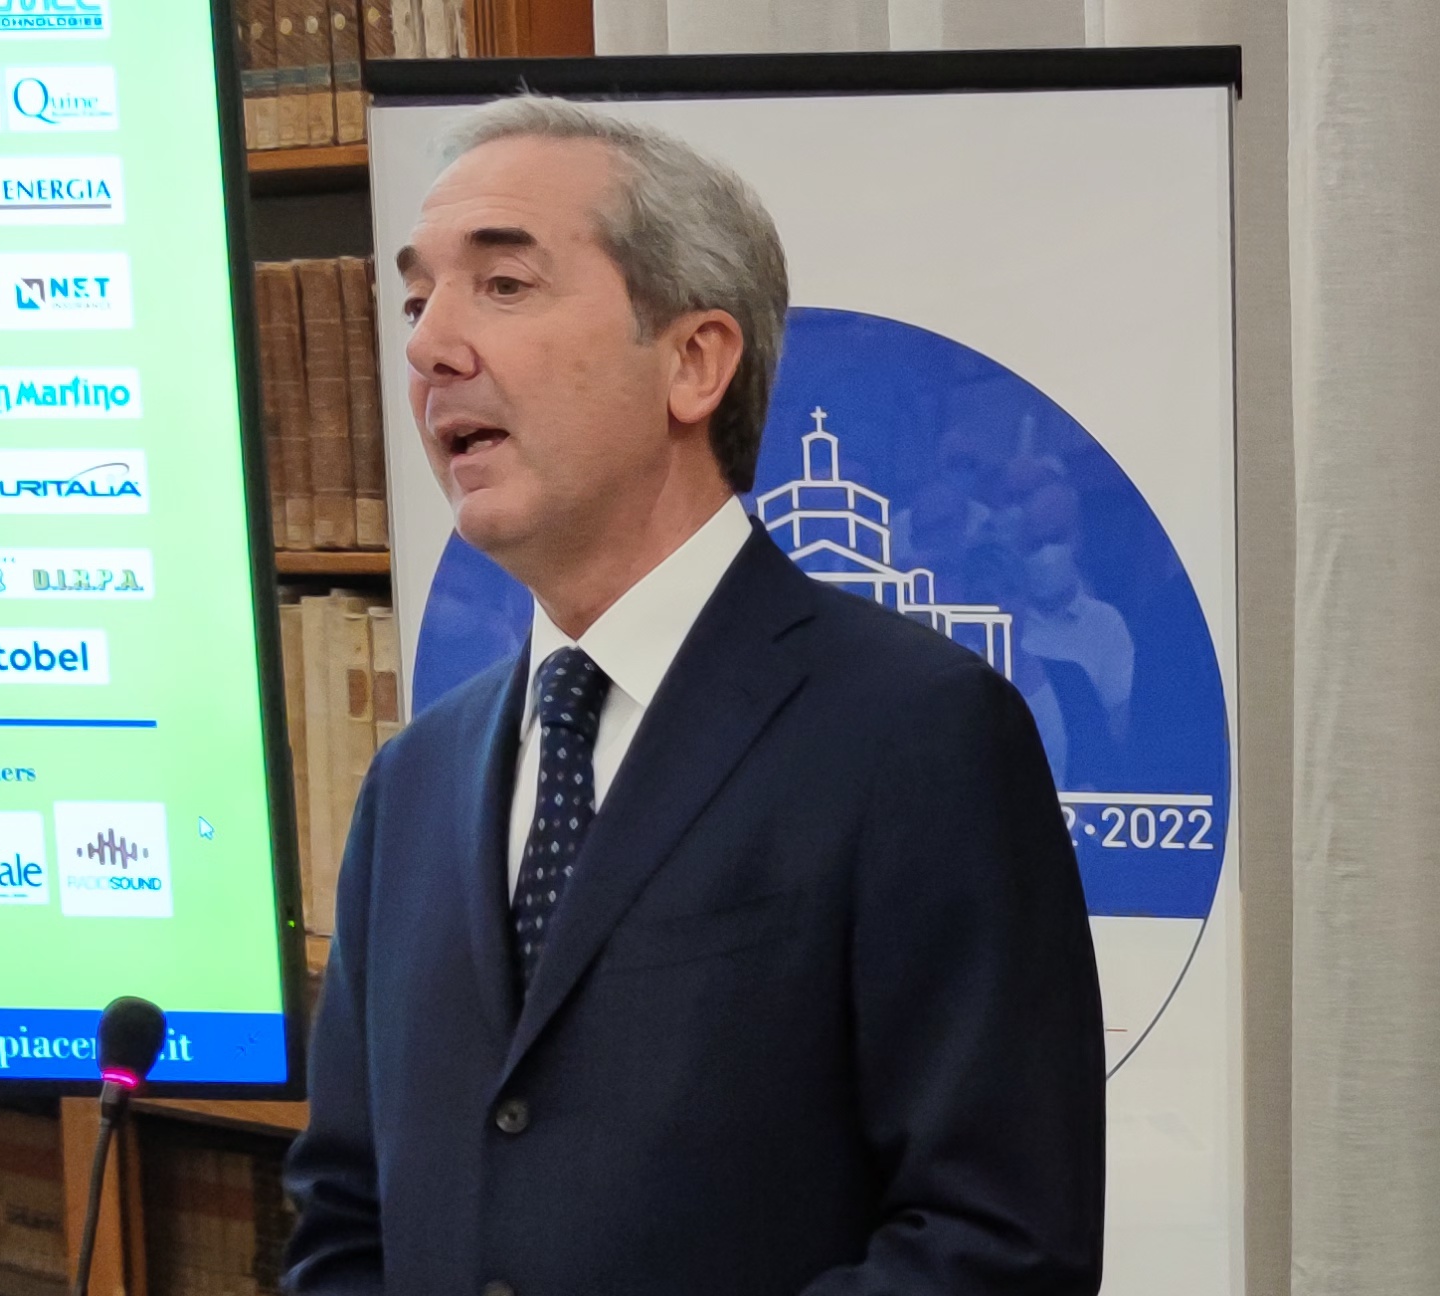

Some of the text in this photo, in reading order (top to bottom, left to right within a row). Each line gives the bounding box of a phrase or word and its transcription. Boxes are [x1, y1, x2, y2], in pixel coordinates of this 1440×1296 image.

[3, 178, 112, 201] ENERGIA
[50, 277, 110, 298] NET
[16, 375, 130, 412] Martino
